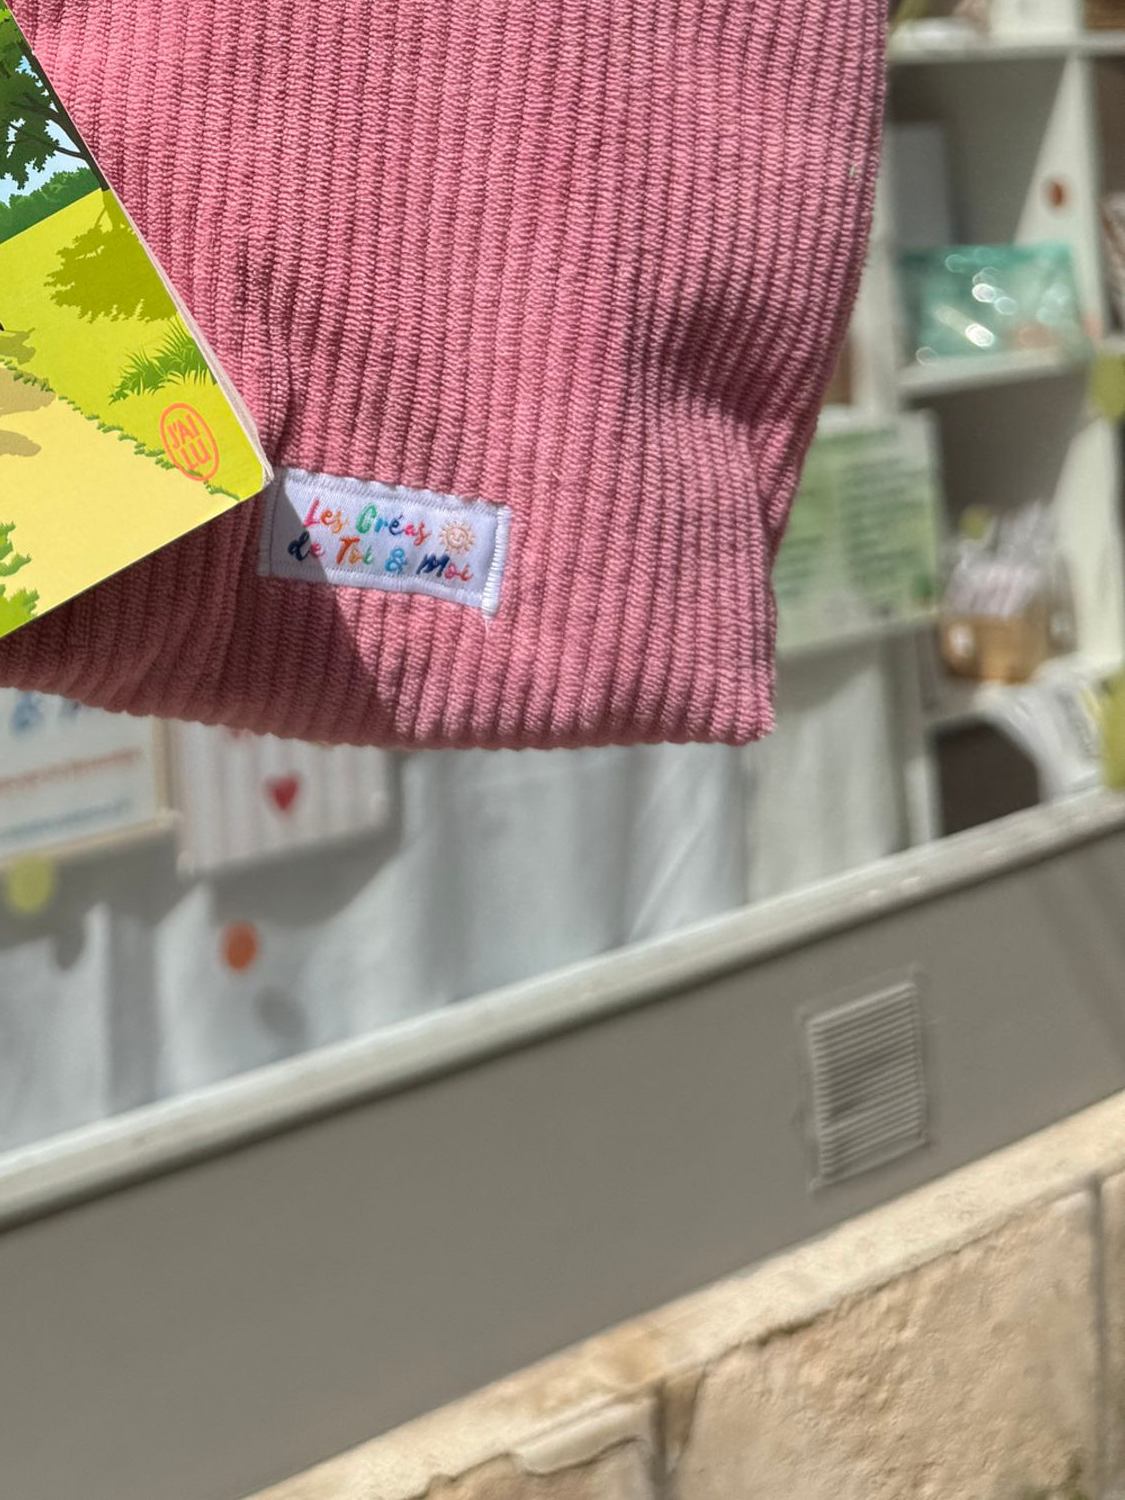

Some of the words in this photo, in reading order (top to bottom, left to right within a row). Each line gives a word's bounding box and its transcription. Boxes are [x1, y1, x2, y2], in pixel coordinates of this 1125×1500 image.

[167, 413, 200, 450] J'AI
[182, 439, 212, 470] LU
[303, 497, 348, 534] Les
[356, 503, 431, 546] Créas
[287, 530, 325, 561] de
[384, 548, 409, 574] &
[416, 552, 475, 582] Moi
